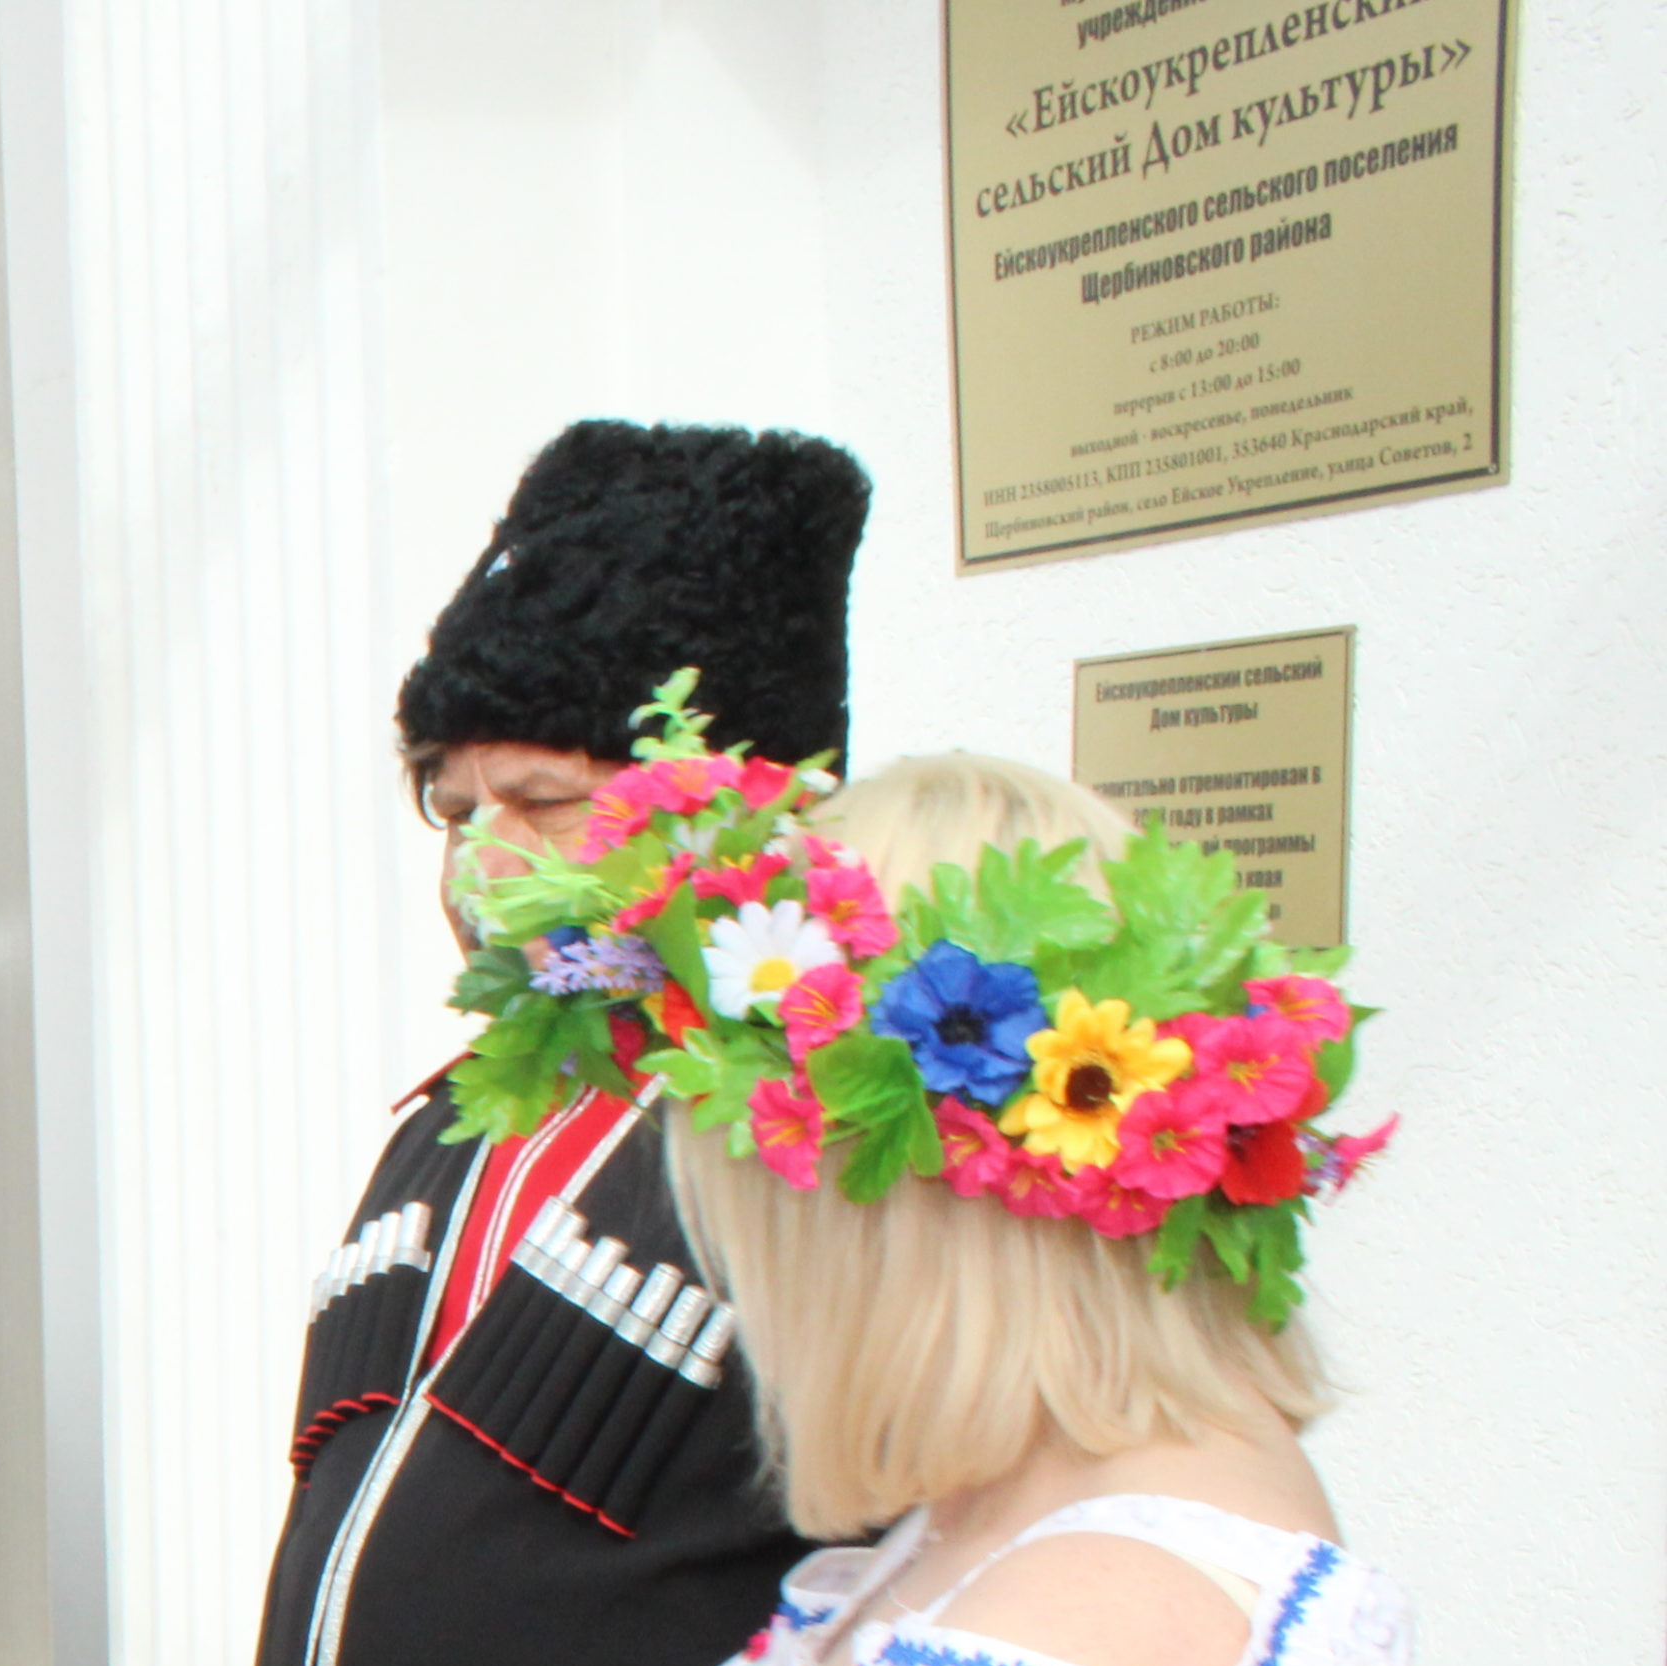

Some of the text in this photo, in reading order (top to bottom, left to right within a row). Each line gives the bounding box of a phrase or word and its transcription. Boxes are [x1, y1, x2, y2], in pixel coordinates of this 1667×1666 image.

[1005, 0, 1422, 138] «Ейскоукрепленск
[976, 38, 1472, 218] сельский Дом культуры»
[994, 123, 1458, 281] Ейскоукрепленского сельского поселения
[1081, 211, 1332, 304] Щербиновского района
[1130, 293, 1280, 344] РЕЖИМ РАБОТЫ:
[1150, 332, 1260, 373] с 8:00 до 20:00
[1114, 358, 1301, 416] перерыв с 13:00 до 15:00
[984, 484, 1017, 507] ИНН
[1106, 461, 1141, 483] КПП
[1291, 406, 1421, 449] Краснодарский
[1425, 396, 1473, 424] край,
[1070, 430, 1138, 458] выходной
[1150, 410, 1247, 442] воскресенье,
[1250, 386, 1354, 420] понедельник
[1137, 494, 1167, 511] село
[1171, 483, 1224, 505] Ейское
[1327, 456, 1374, 482] улица
[1379, 439, 1457, 466] Советов,
[1463, 432, 1473, 451] 2
[1245, 655, 1323, 688] сельский
[1150, 702, 1258, 732] Дом культуры
[1179, 767, 1308, 795] отремонтирован
[1218, 804, 1274, 827] рамках
